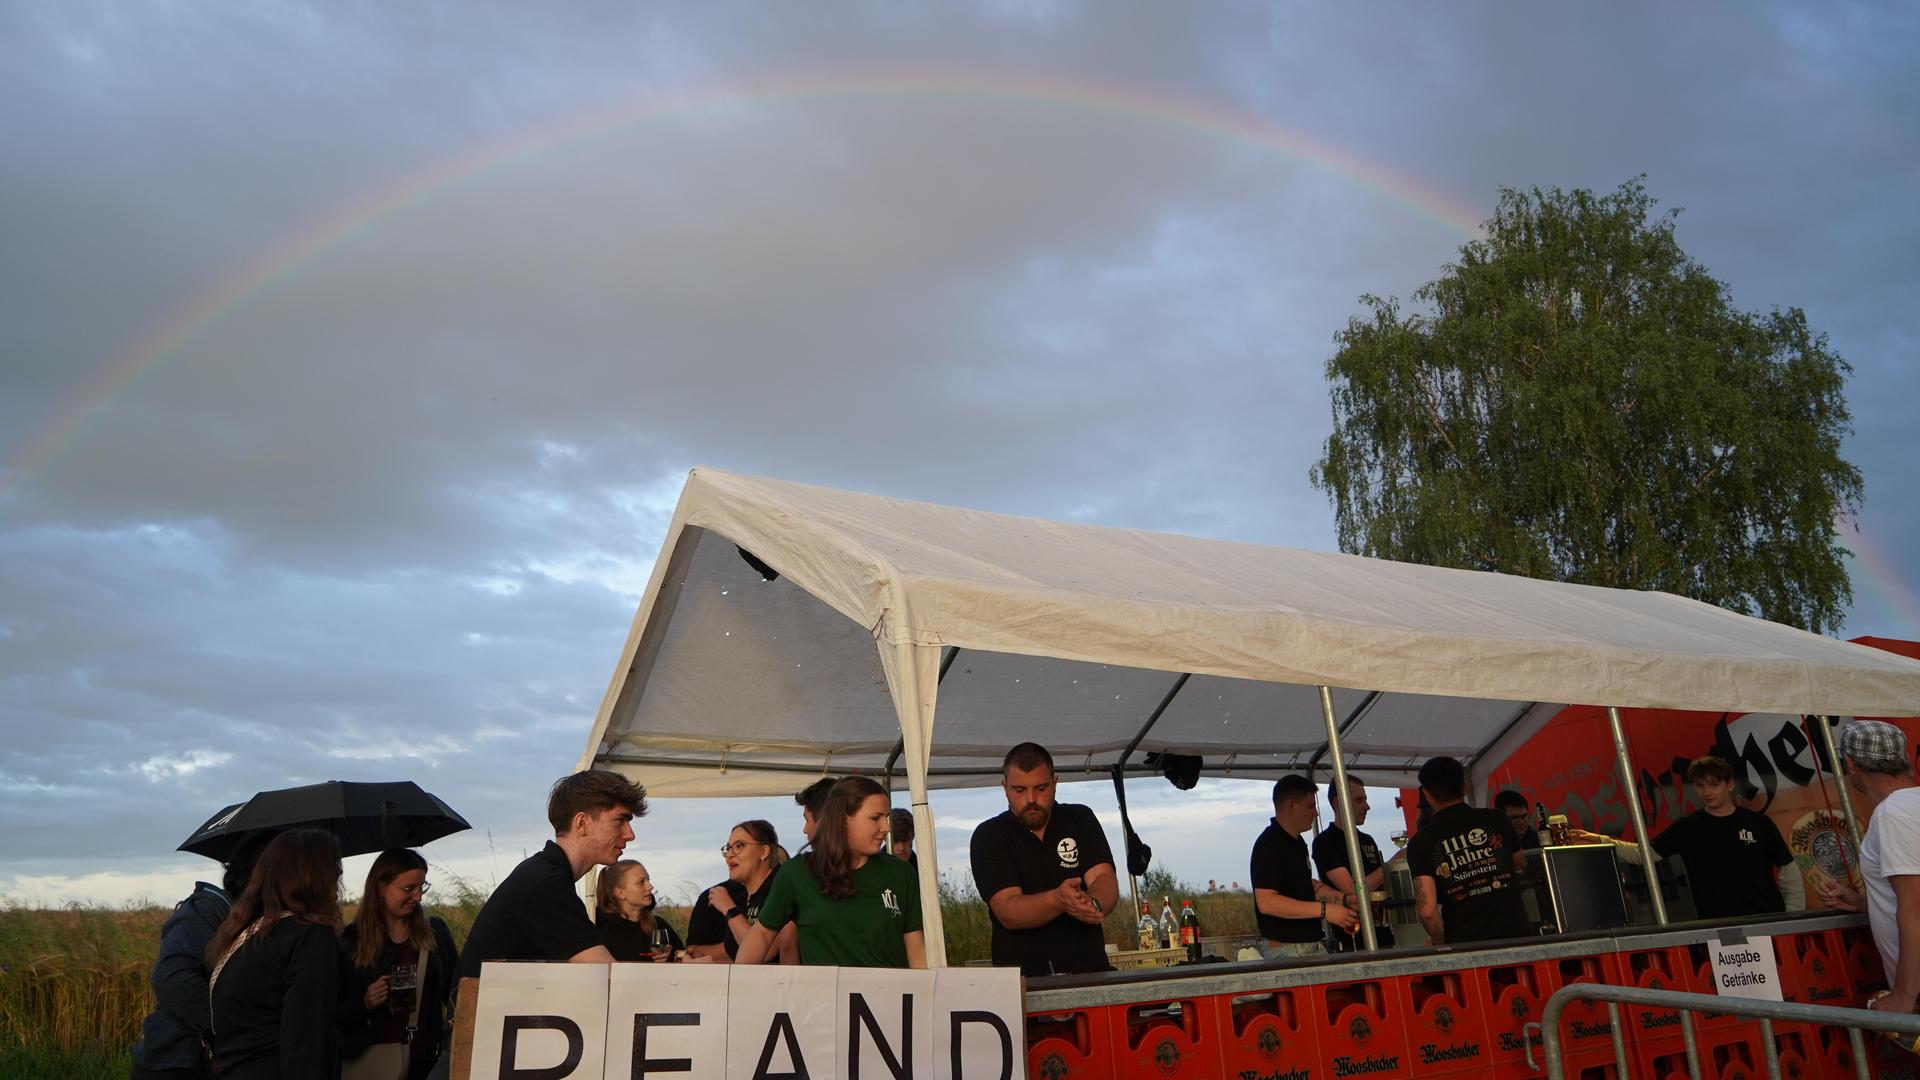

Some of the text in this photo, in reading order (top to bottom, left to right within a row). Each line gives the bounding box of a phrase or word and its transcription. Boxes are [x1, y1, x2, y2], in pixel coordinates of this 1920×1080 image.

[1447, 847, 1494, 871] Jahre
[1718, 949, 1761, 968] Ausgabe
[1722, 971, 1766, 988] Getränke
[1420, 1041, 1480, 1064] Moosbacher
[1333, 1053, 1398, 1077] Moosbacher
